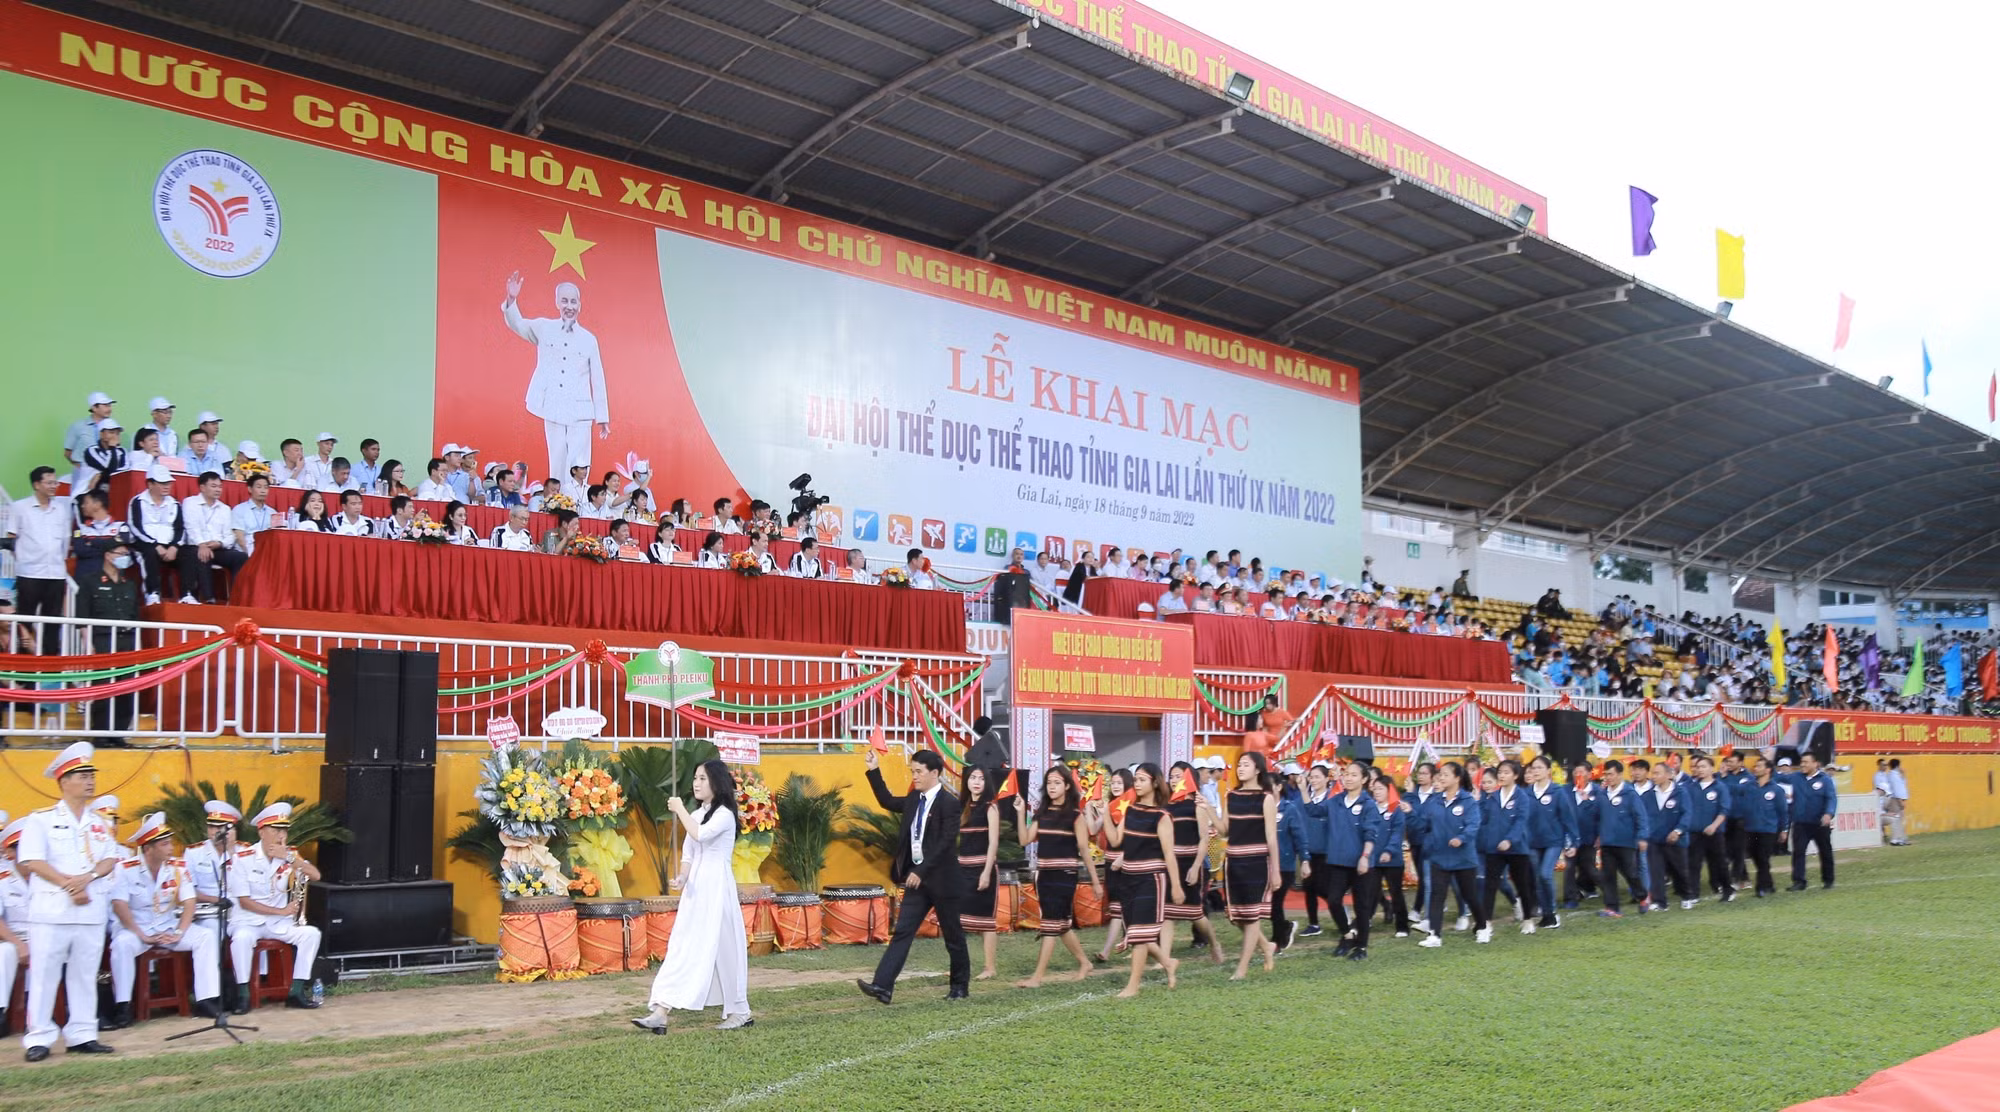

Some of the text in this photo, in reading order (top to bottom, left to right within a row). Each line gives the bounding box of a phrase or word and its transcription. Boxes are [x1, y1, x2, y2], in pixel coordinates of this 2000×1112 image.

[1132, 22, 1198, 77] THAO
[1204, 54, 1261, 106] TỈH
[1267, 86, 1305, 126] GIA
[1311, 105, 1344, 143] LAI
[1349, 122, 1388, 163] LẦN
[1392, 143, 1430, 179] THỨ
[1433, 162, 1451, 191] IX
[1455, 173, 1495, 212] NĂM
[60, 32, 267, 111] NƯỚC
[293, 94, 468, 164] CỘNG
[490, 143, 602, 197] HÒA
[619, 177, 688, 219] XÃ
[704, 199, 781, 243] HỘI
[797, 226, 882, 267] CHỦ
[896, 251, 1013, 303] NGHĨA
[1023, 285, 1094, 323] VIỆT
[1104, 308, 1175, 346] NAM
[1184, 330, 1266, 370] MUÔN
[1274, 355, 1332, 388] NĂM
[205, 237, 235, 253] 2022
[947, 332, 1249, 457] LỄ KHAI MẠC
[807, 394, 1335, 526] ĐẠI HỘI THỂ DỤC THỂ THAO TỈNH GIA LAI LẦN THỨ IX NĂM 2022
[1017, 483, 1195, 527] Gia Lai, ngày 18 tháng 9 năm 2022
[680, 672, 709, 684] PLEIKU
[1865, 723, 1901, 742] TRUNG
[1936, 725, 1957, 743] CAO
